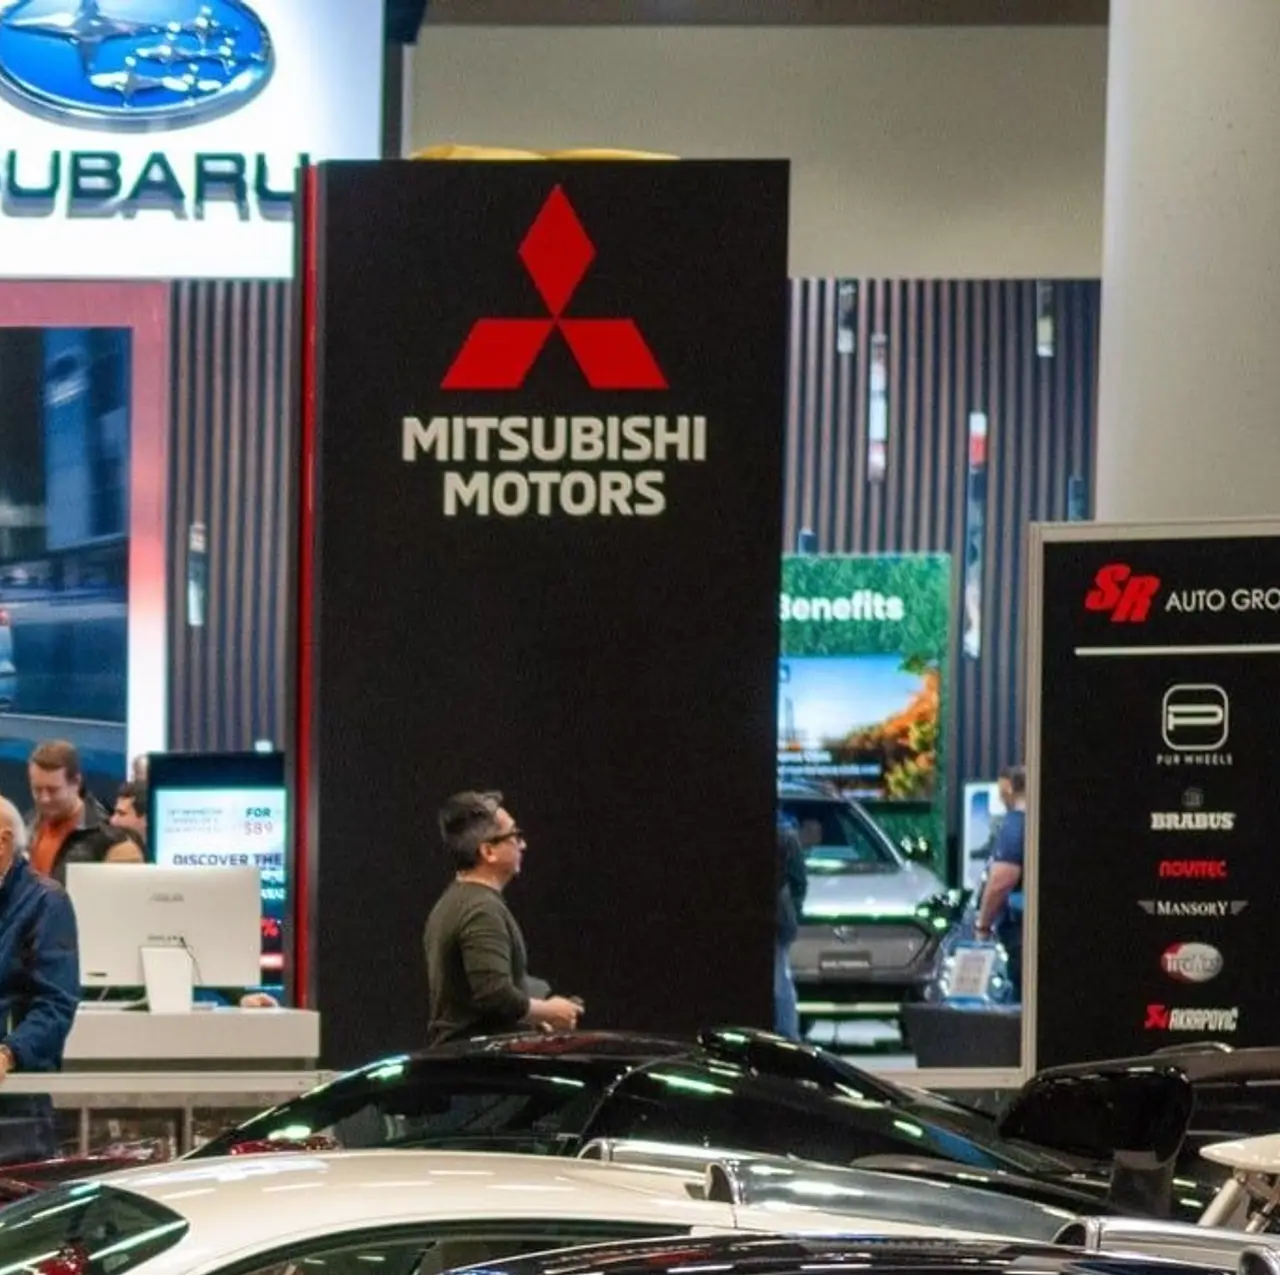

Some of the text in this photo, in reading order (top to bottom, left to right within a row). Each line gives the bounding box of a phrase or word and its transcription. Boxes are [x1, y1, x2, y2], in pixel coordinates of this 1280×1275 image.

[401, 415, 707, 462] MITSUBISHI
[443, 470, 667, 517] MOTORS
[1085, 562, 1161, 623] SR
[1165, 588, 1226, 613] AUTO
[1155, 753, 1234, 766] PUR WHEELS
[244, 807, 272, 818] FOR
[1150, 811, 1237, 831] BRABUS
[172, 853, 249, 867] DISCOVER
